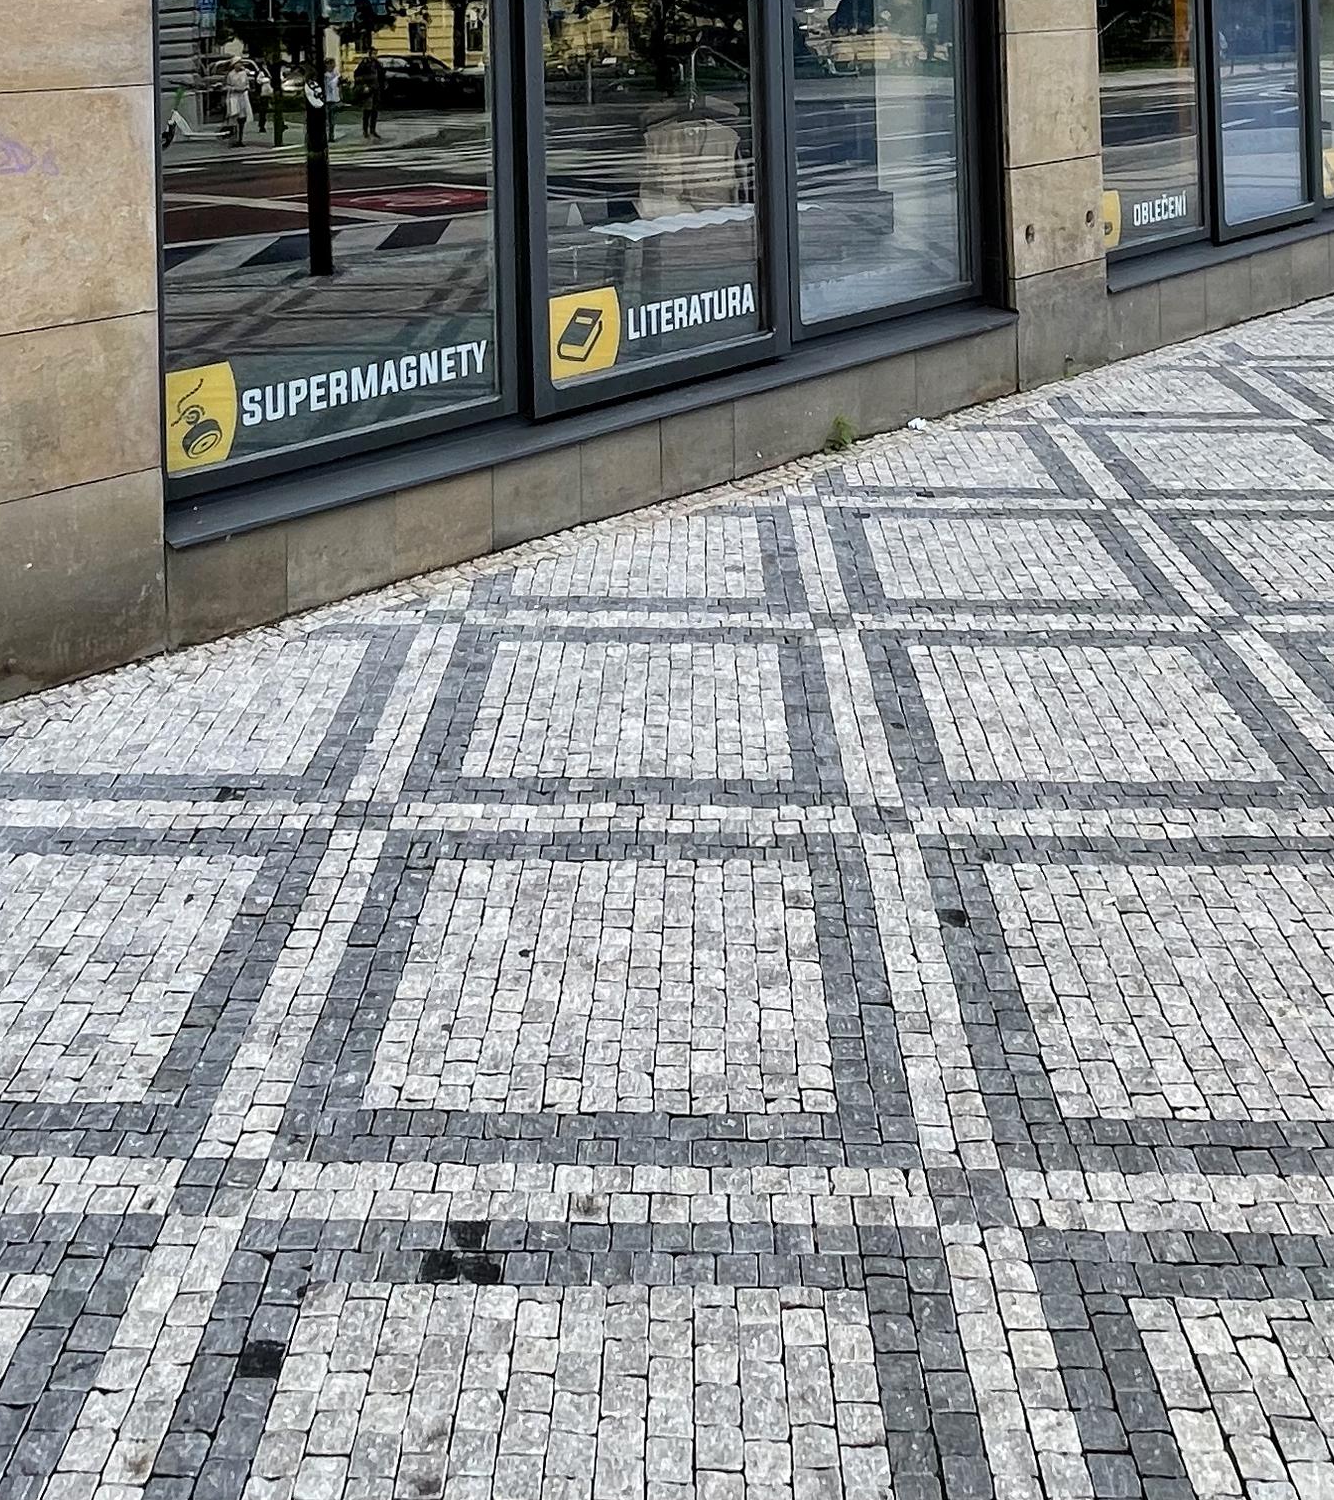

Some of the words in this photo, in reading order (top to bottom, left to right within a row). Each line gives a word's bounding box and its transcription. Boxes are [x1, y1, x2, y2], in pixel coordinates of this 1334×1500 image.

[1133, 190, 1187, 227] OBLEČENÍ
[627, 283, 755, 340] LITERATURA
[242, 339, 487, 427] SUPERMAGNETY
